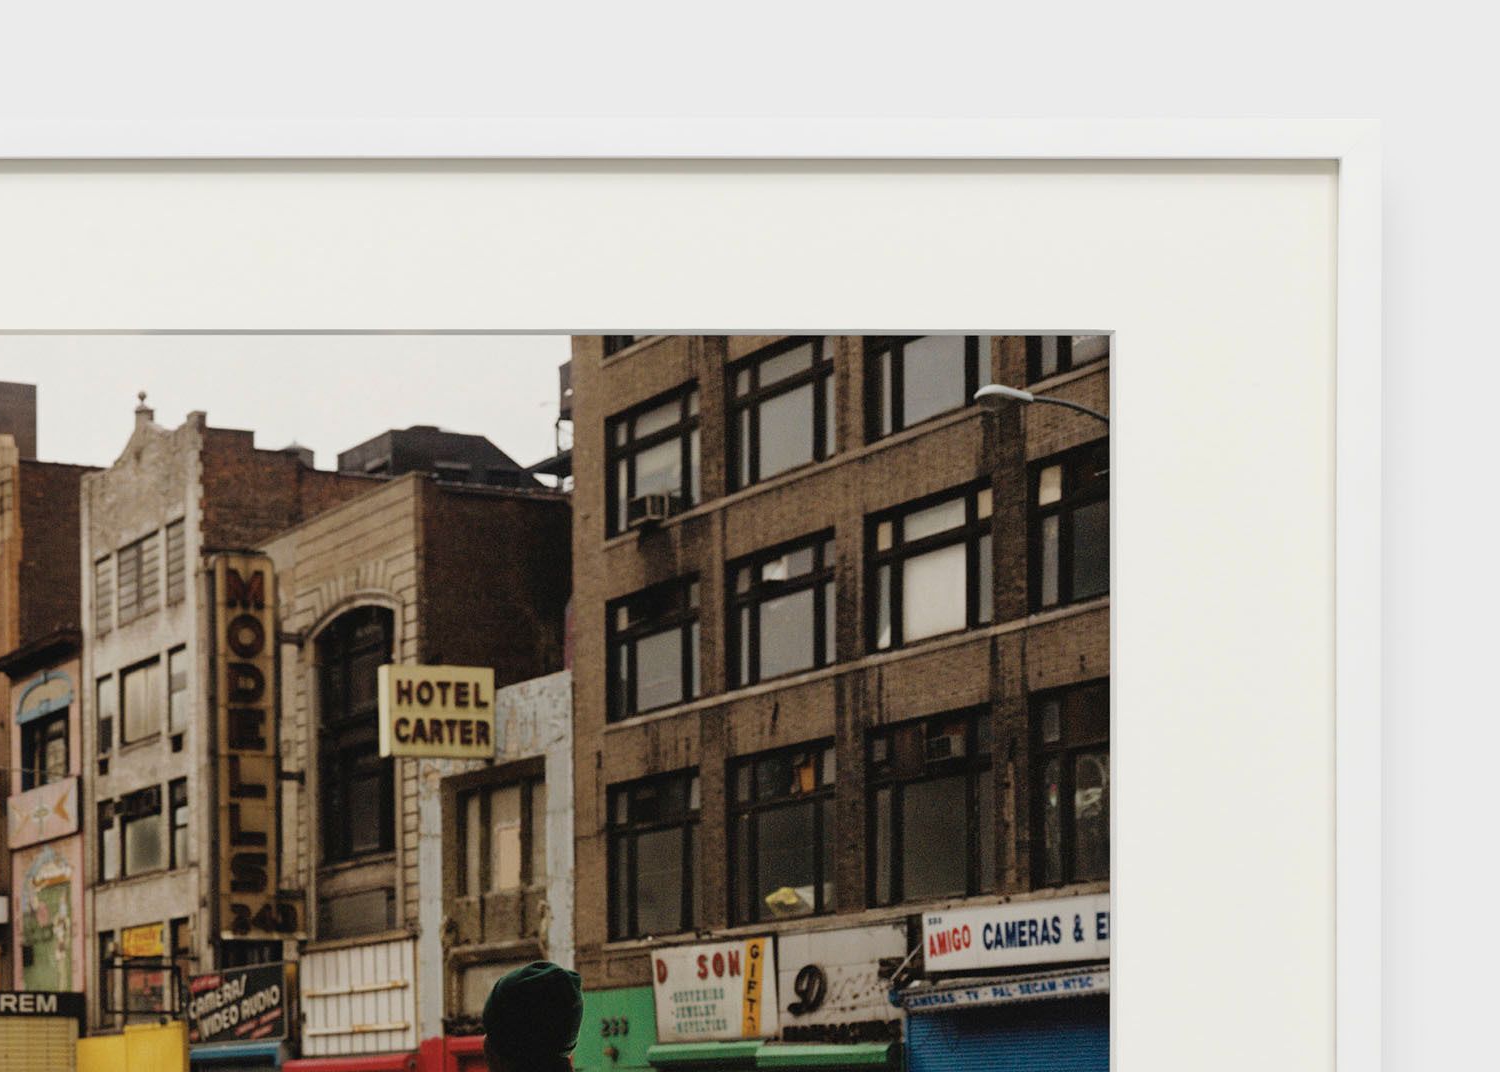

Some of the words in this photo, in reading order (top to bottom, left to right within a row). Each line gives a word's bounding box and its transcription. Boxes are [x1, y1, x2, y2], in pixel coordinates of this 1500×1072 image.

[396, 680, 489, 708] HOTEL
[395, 717, 490, 746] CARTER
[928, 924, 971, 958] AMIGO
[982, 915, 1061, 950] CAMERAS
[1073, 914, 1084, 942] &
[697, 949, 740, 979] SON
[200, 1004, 239, 1040] VIDEO
[241, 984, 280, 1019] AUDIO
